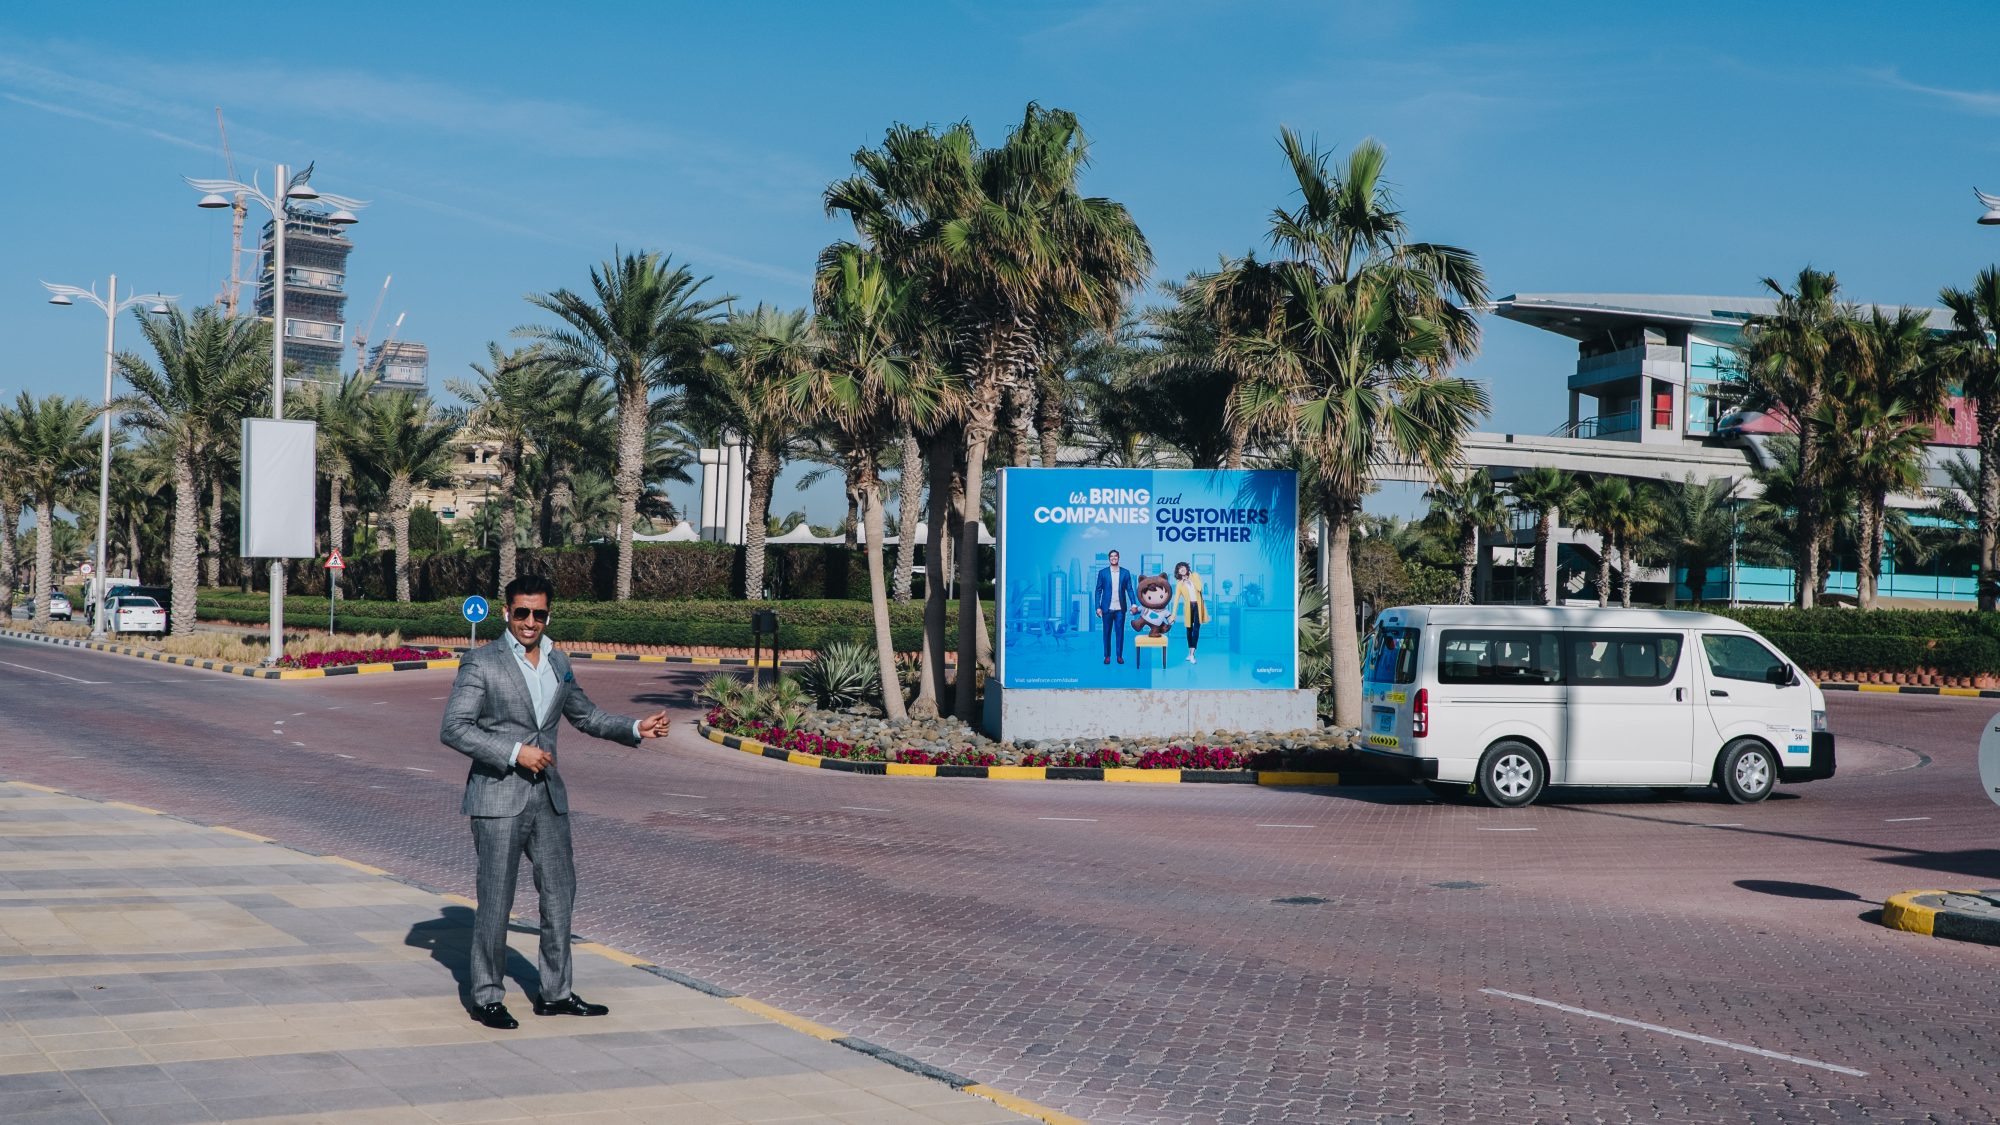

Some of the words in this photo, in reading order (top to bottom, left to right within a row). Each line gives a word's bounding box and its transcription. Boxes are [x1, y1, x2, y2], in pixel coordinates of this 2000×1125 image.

[1089, 488, 1151, 505] BRING
[1156, 492, 1182, 505] and
[1034, 506, 1150, 524] COMPANIES
[1155, 508, 1269, 525] CUSTOMERS
[1156, 526, 1251, 543] TOGETHER
